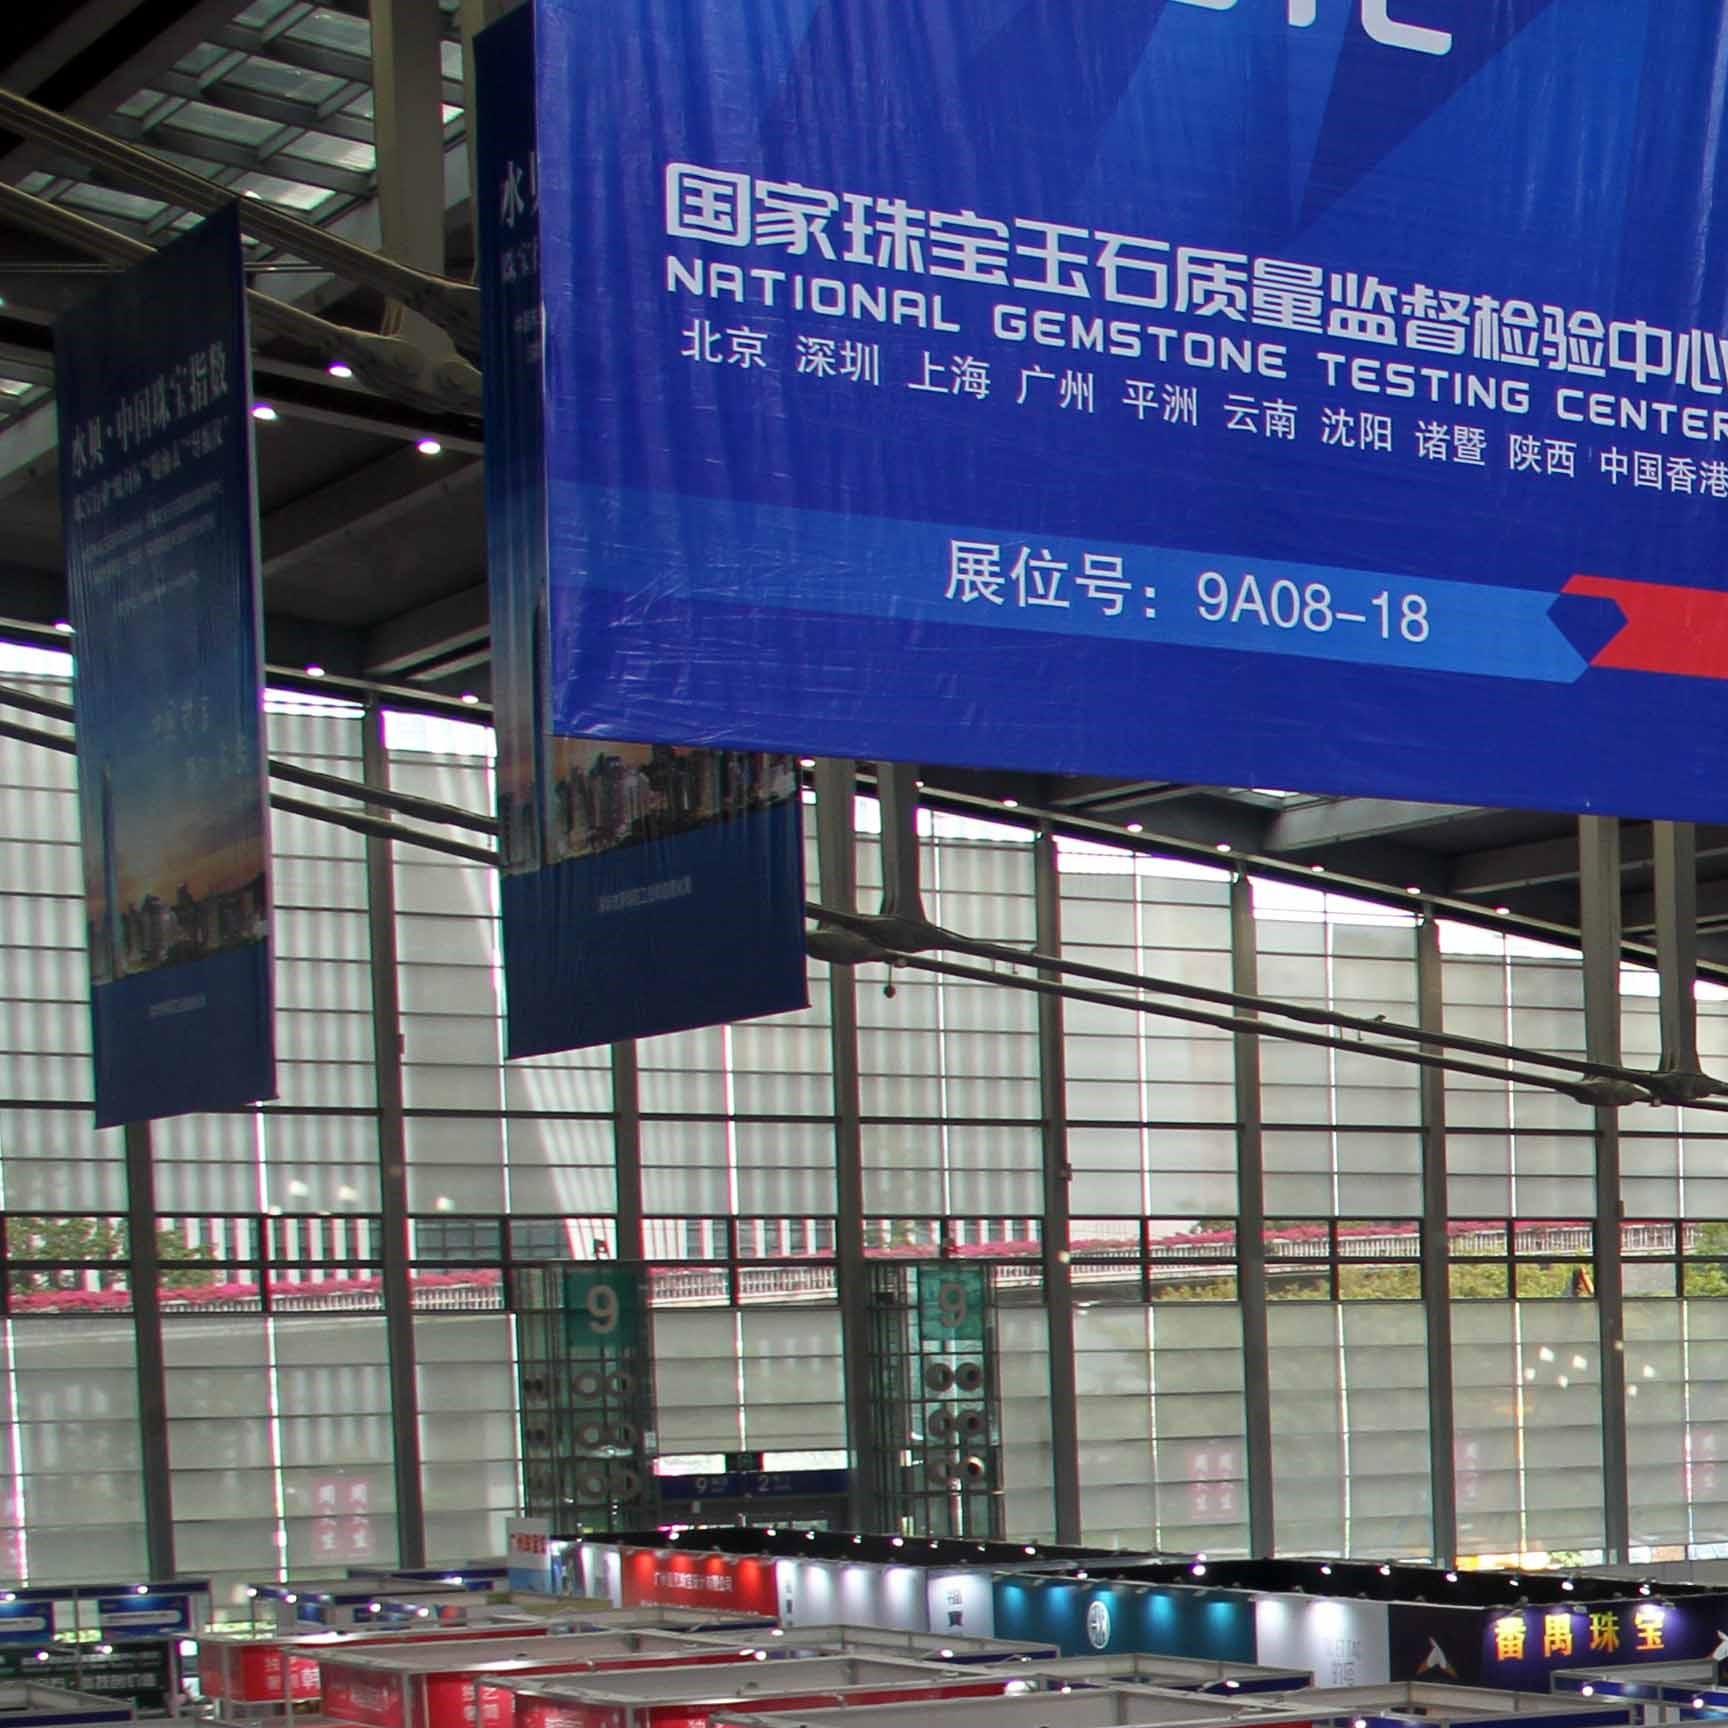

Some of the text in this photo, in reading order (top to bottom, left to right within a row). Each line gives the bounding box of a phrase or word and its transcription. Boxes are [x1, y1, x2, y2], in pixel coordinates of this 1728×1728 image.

[667, 256, 961, 333] NATIONAL
[993, 304, 1288, 379] GEMSTONE
[1317, 352, 1531, 415] TESTING
[681, 319, 768, 370] 北京
[796, 335, 881, 386] 深圳
[907, 351, 992, 400] 上海
[1017, 365, 1096, 413] 广州
[1122, 379, 1199, 427] 平洲
[1223, 393, 1298, 441] 云南
[1321, 407, 1393, 453] 沈阳
[1415, 420, 1487, 466] 诸暨
[1508, 433, 1578, 478] 陕西
[585, 1285, 620, 1335] 9
[939, 1283, 968, 1329] 9
[1495, 1611, 1666, 1661] 番禺珠宝
